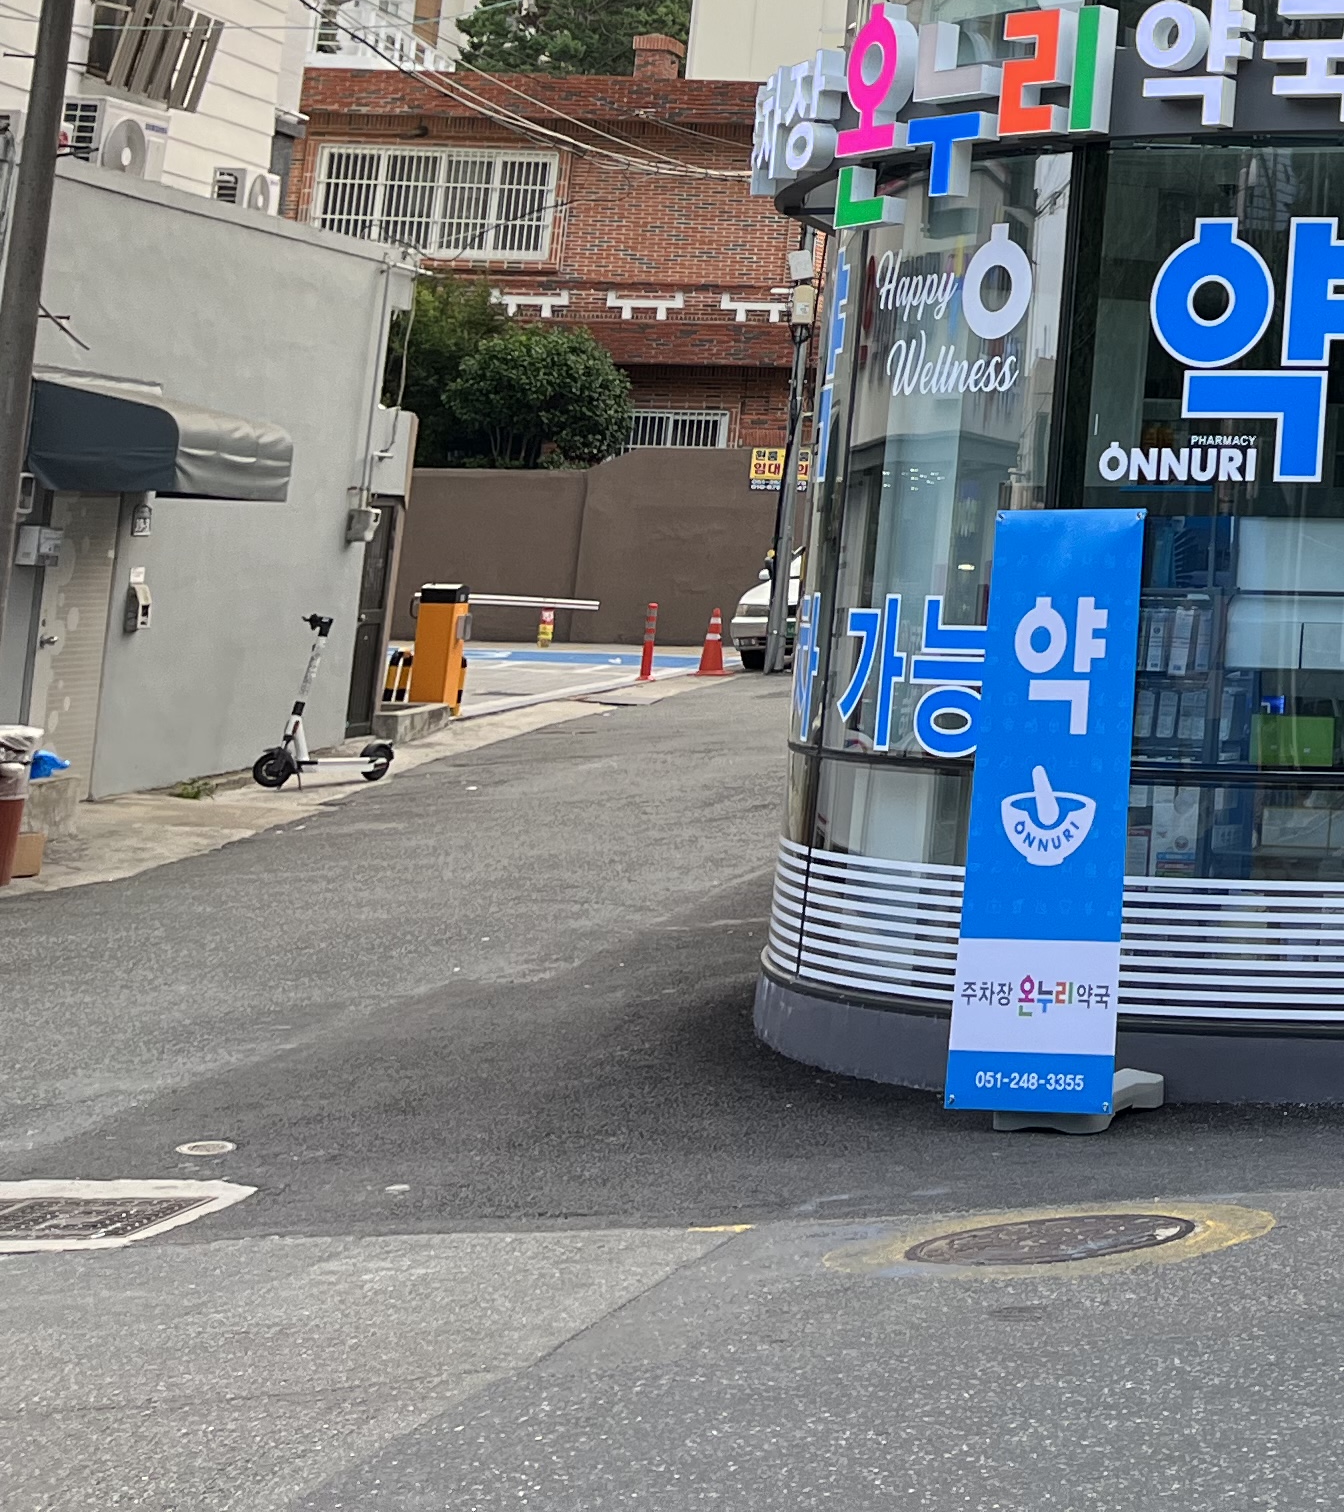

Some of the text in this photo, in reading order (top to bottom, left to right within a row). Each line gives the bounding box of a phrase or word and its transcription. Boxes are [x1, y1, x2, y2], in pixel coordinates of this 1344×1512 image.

[875, 249, 959, 321] Happy
[886, 338, 1018, 397] Wellness
[1190, 434, 1257, 447] PHARMACY
[1099, 441, 1257, 483] ONNURI
[1013, 595, 1108, 735] 약
[1012, 819, 1082, 852] ONNURI
[959, 982, 1014, 1007] 주차장
[1076, 984, 1111, 1011] 약국
[974, 1070, 1085, 1092] 051-248-3355
